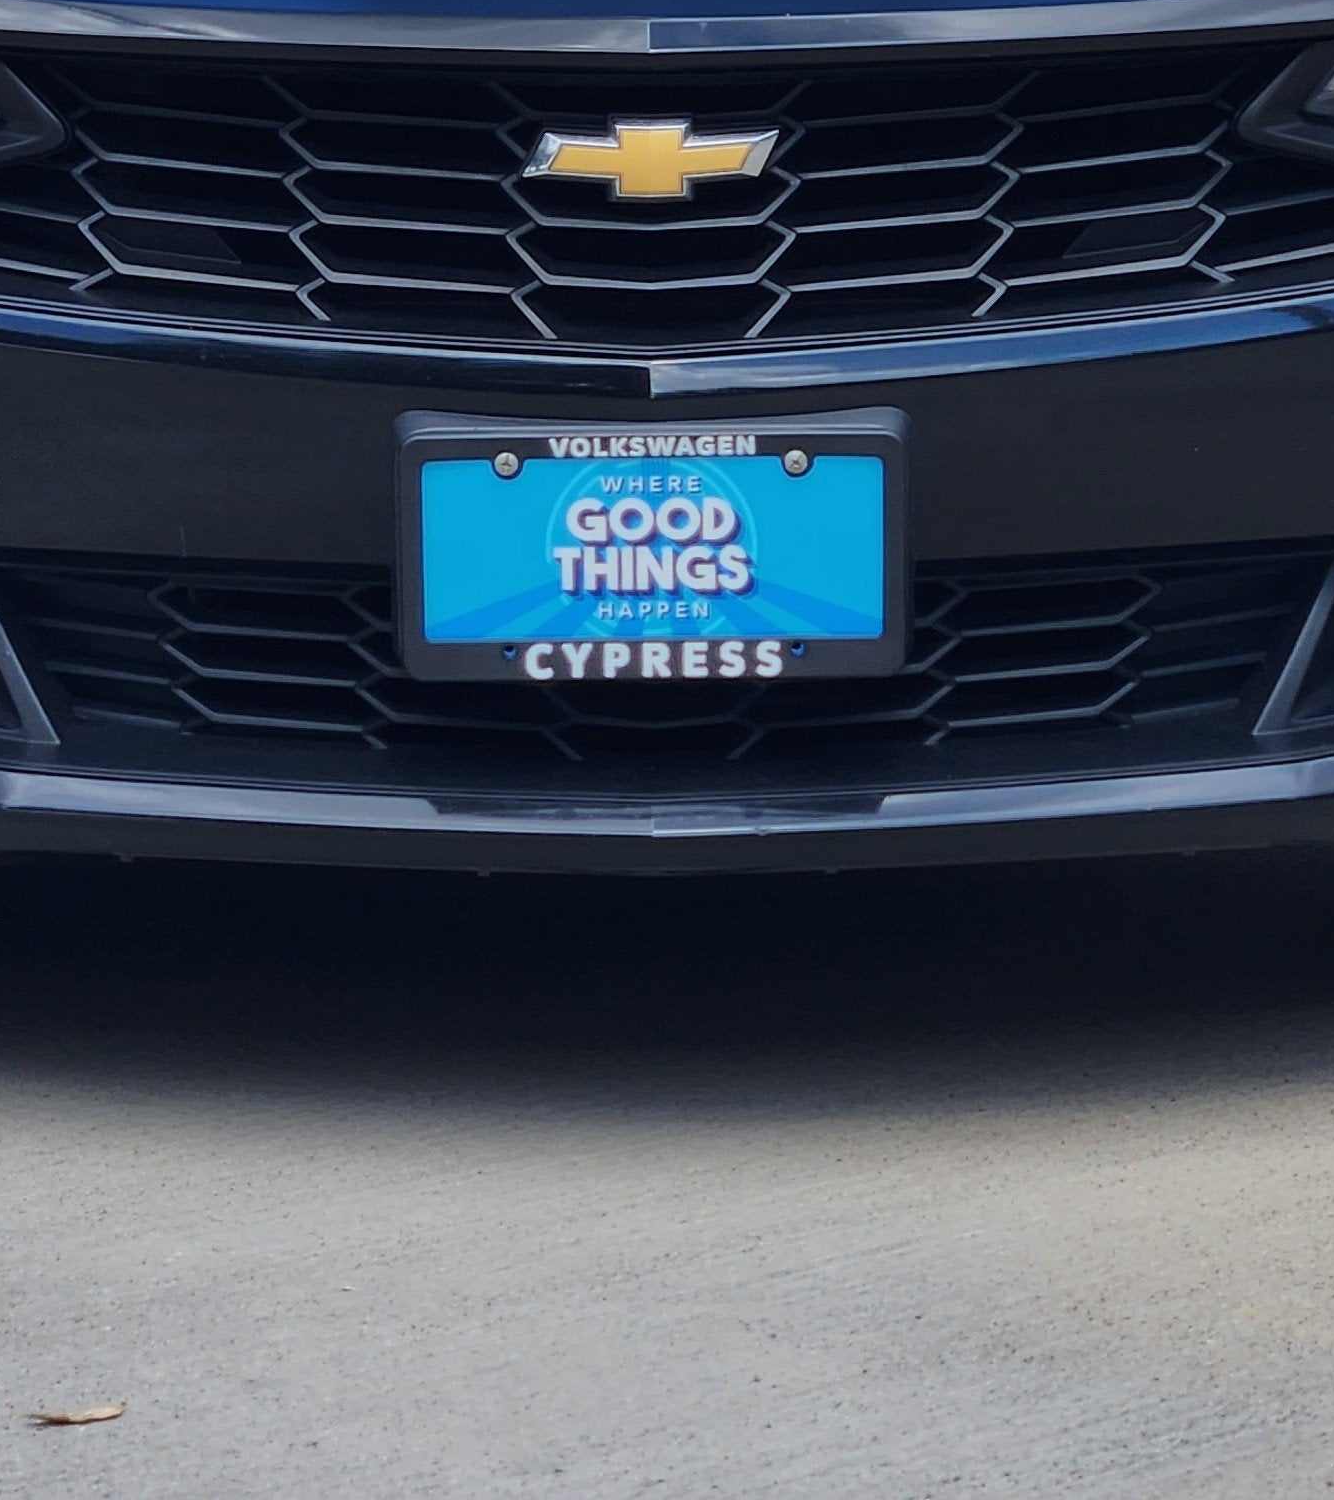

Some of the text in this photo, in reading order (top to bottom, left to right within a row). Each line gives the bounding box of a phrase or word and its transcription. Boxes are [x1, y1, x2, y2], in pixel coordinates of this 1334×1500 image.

[548, 435, 757, 457] VOLKSWAGEN
[600, 475, 702, 493] WHERE
[566, 497, 738, 544] GOOD
[553, 546, 751, 592] THINGS
[599, 602, 711, 619] HAPPEN
[525, 641, 784, 679] CYPRESS
